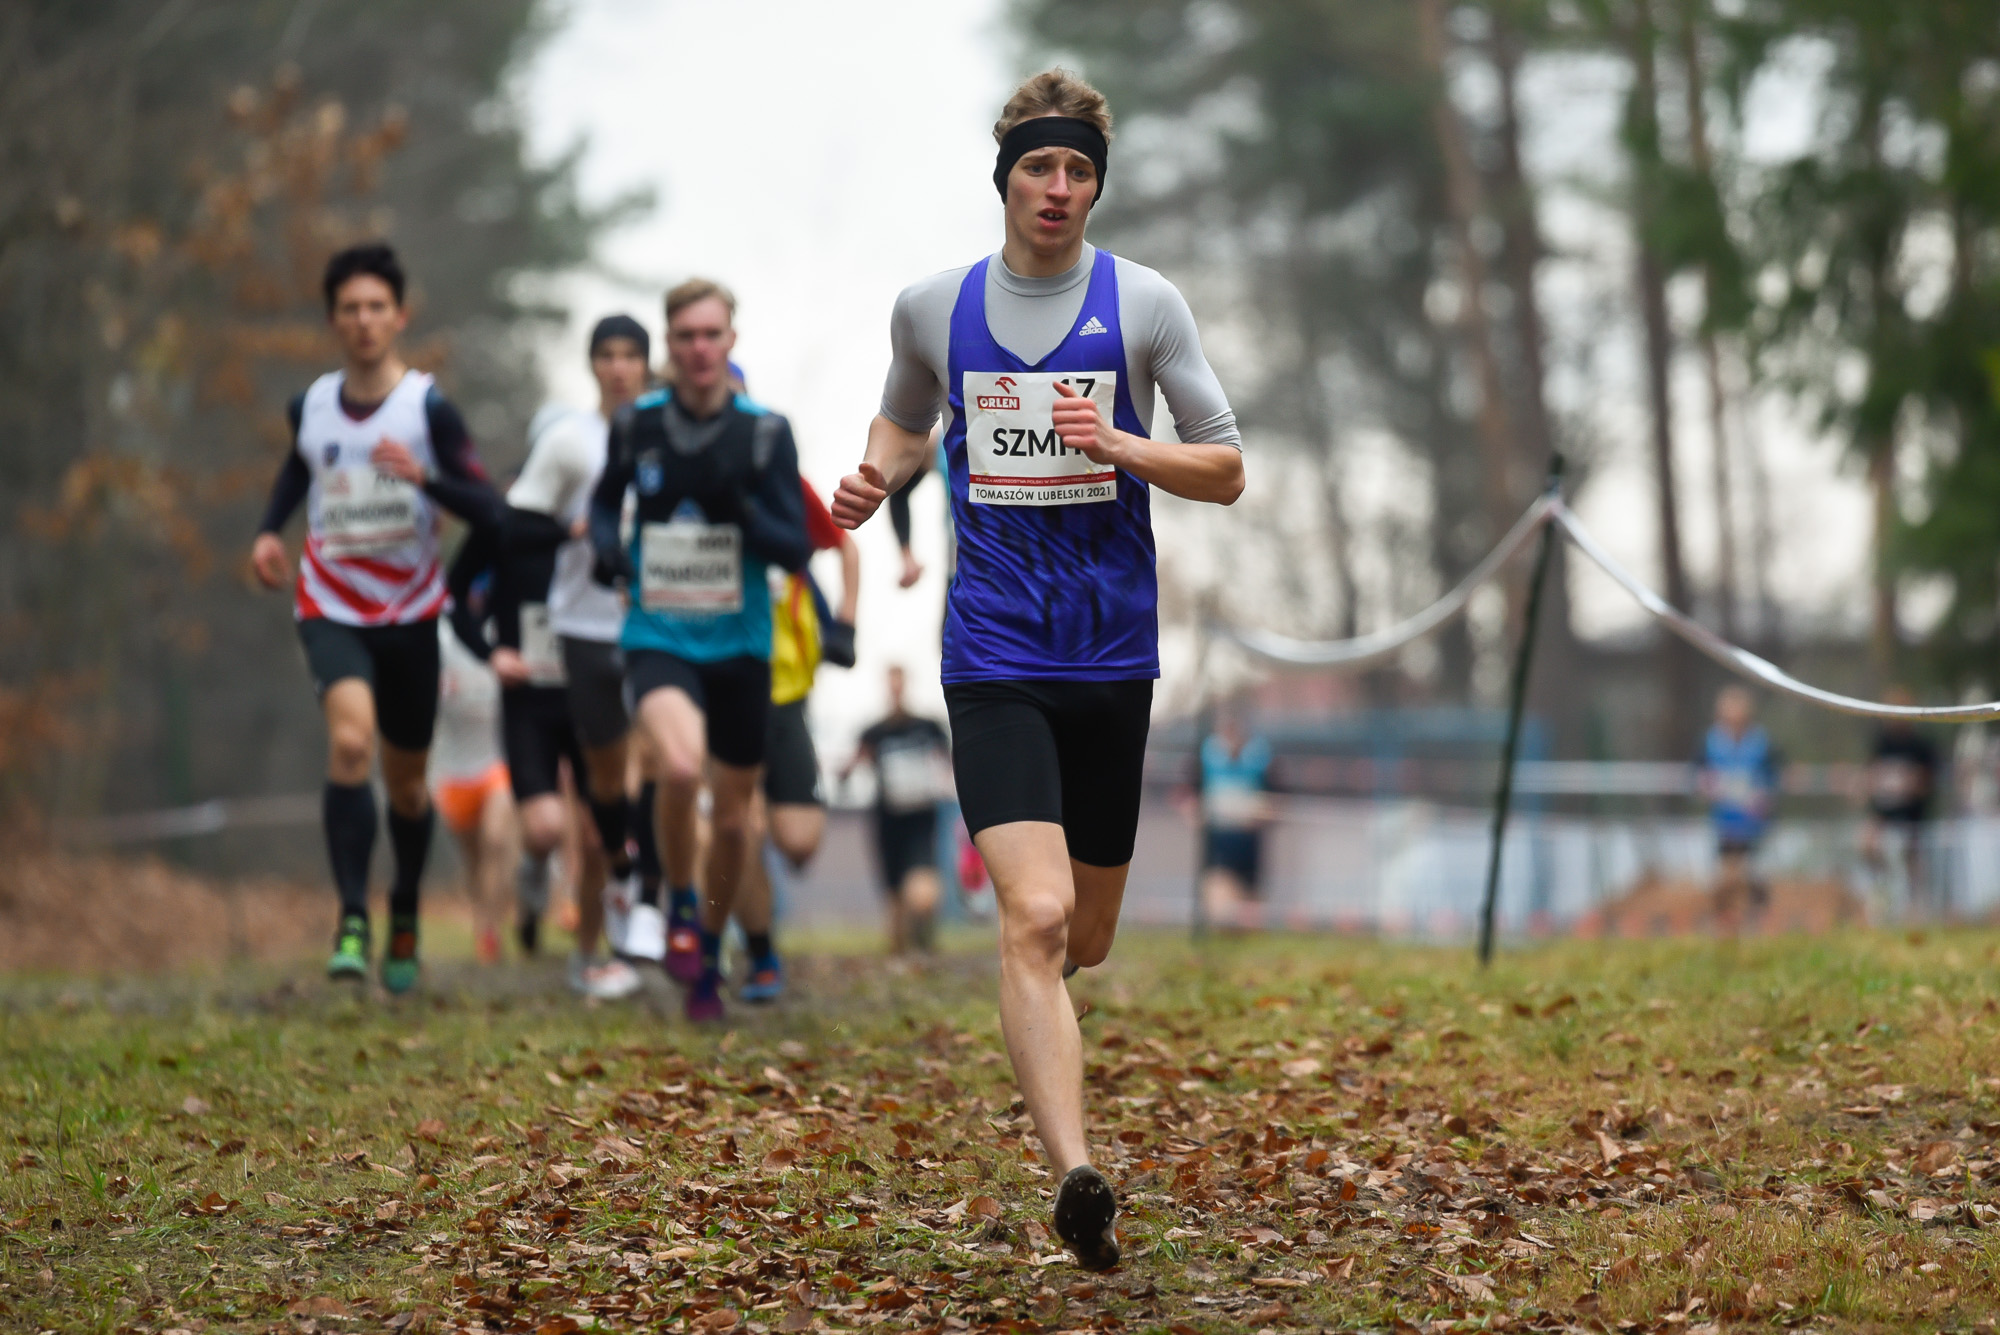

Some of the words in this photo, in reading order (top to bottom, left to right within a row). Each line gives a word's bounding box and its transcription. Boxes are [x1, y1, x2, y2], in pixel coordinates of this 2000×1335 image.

[1078, 327, 1108, 337] adidas
[979, 397, 1018, 409] ORLEN
[992, 428, 1081, 457] SZMI
[976, 488, 1034, 500] TOMASZÓW
[1038, 488, 1084, 501] LUBELSKI
[1087, 486, 1111, 498] 2021
